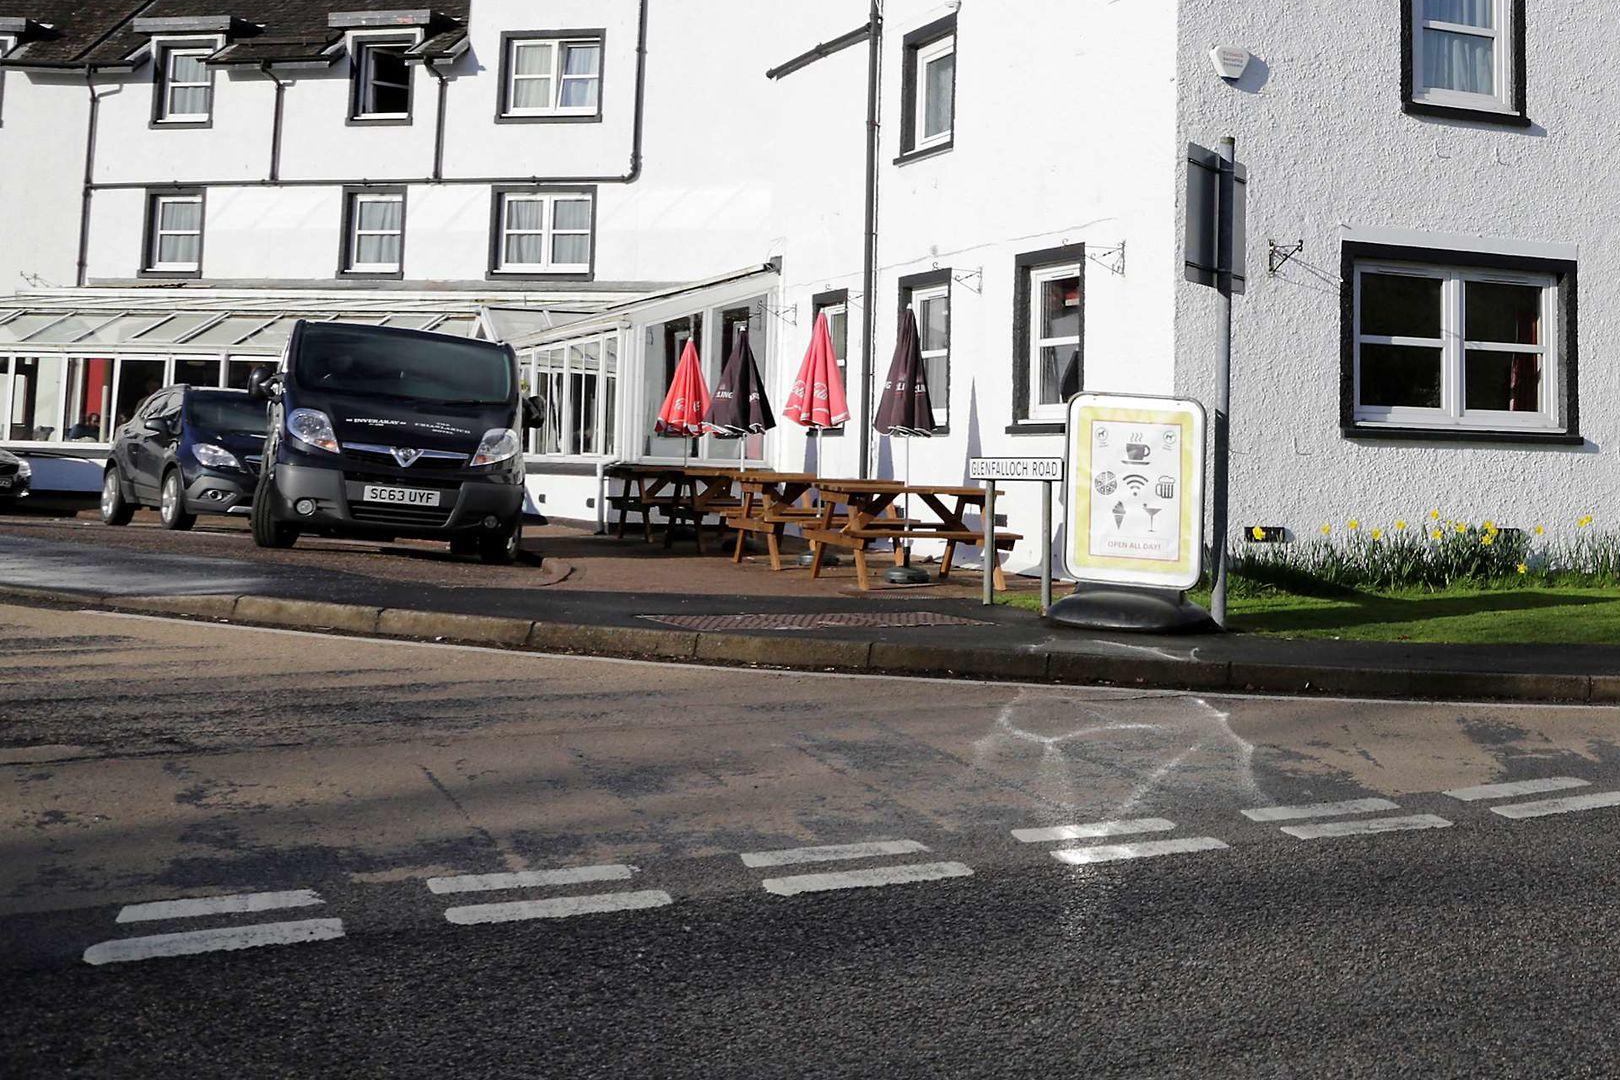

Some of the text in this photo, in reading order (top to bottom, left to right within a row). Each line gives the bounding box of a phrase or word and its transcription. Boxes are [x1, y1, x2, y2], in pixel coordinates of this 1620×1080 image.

[971, 461, 1058, 477] GLENFALLOCH ROAD
[370, 488, 435, 504] SC63 UYF
[1107, 540, 1128, 549] OPEN
[1129, 542, 1142, 550] ALL
